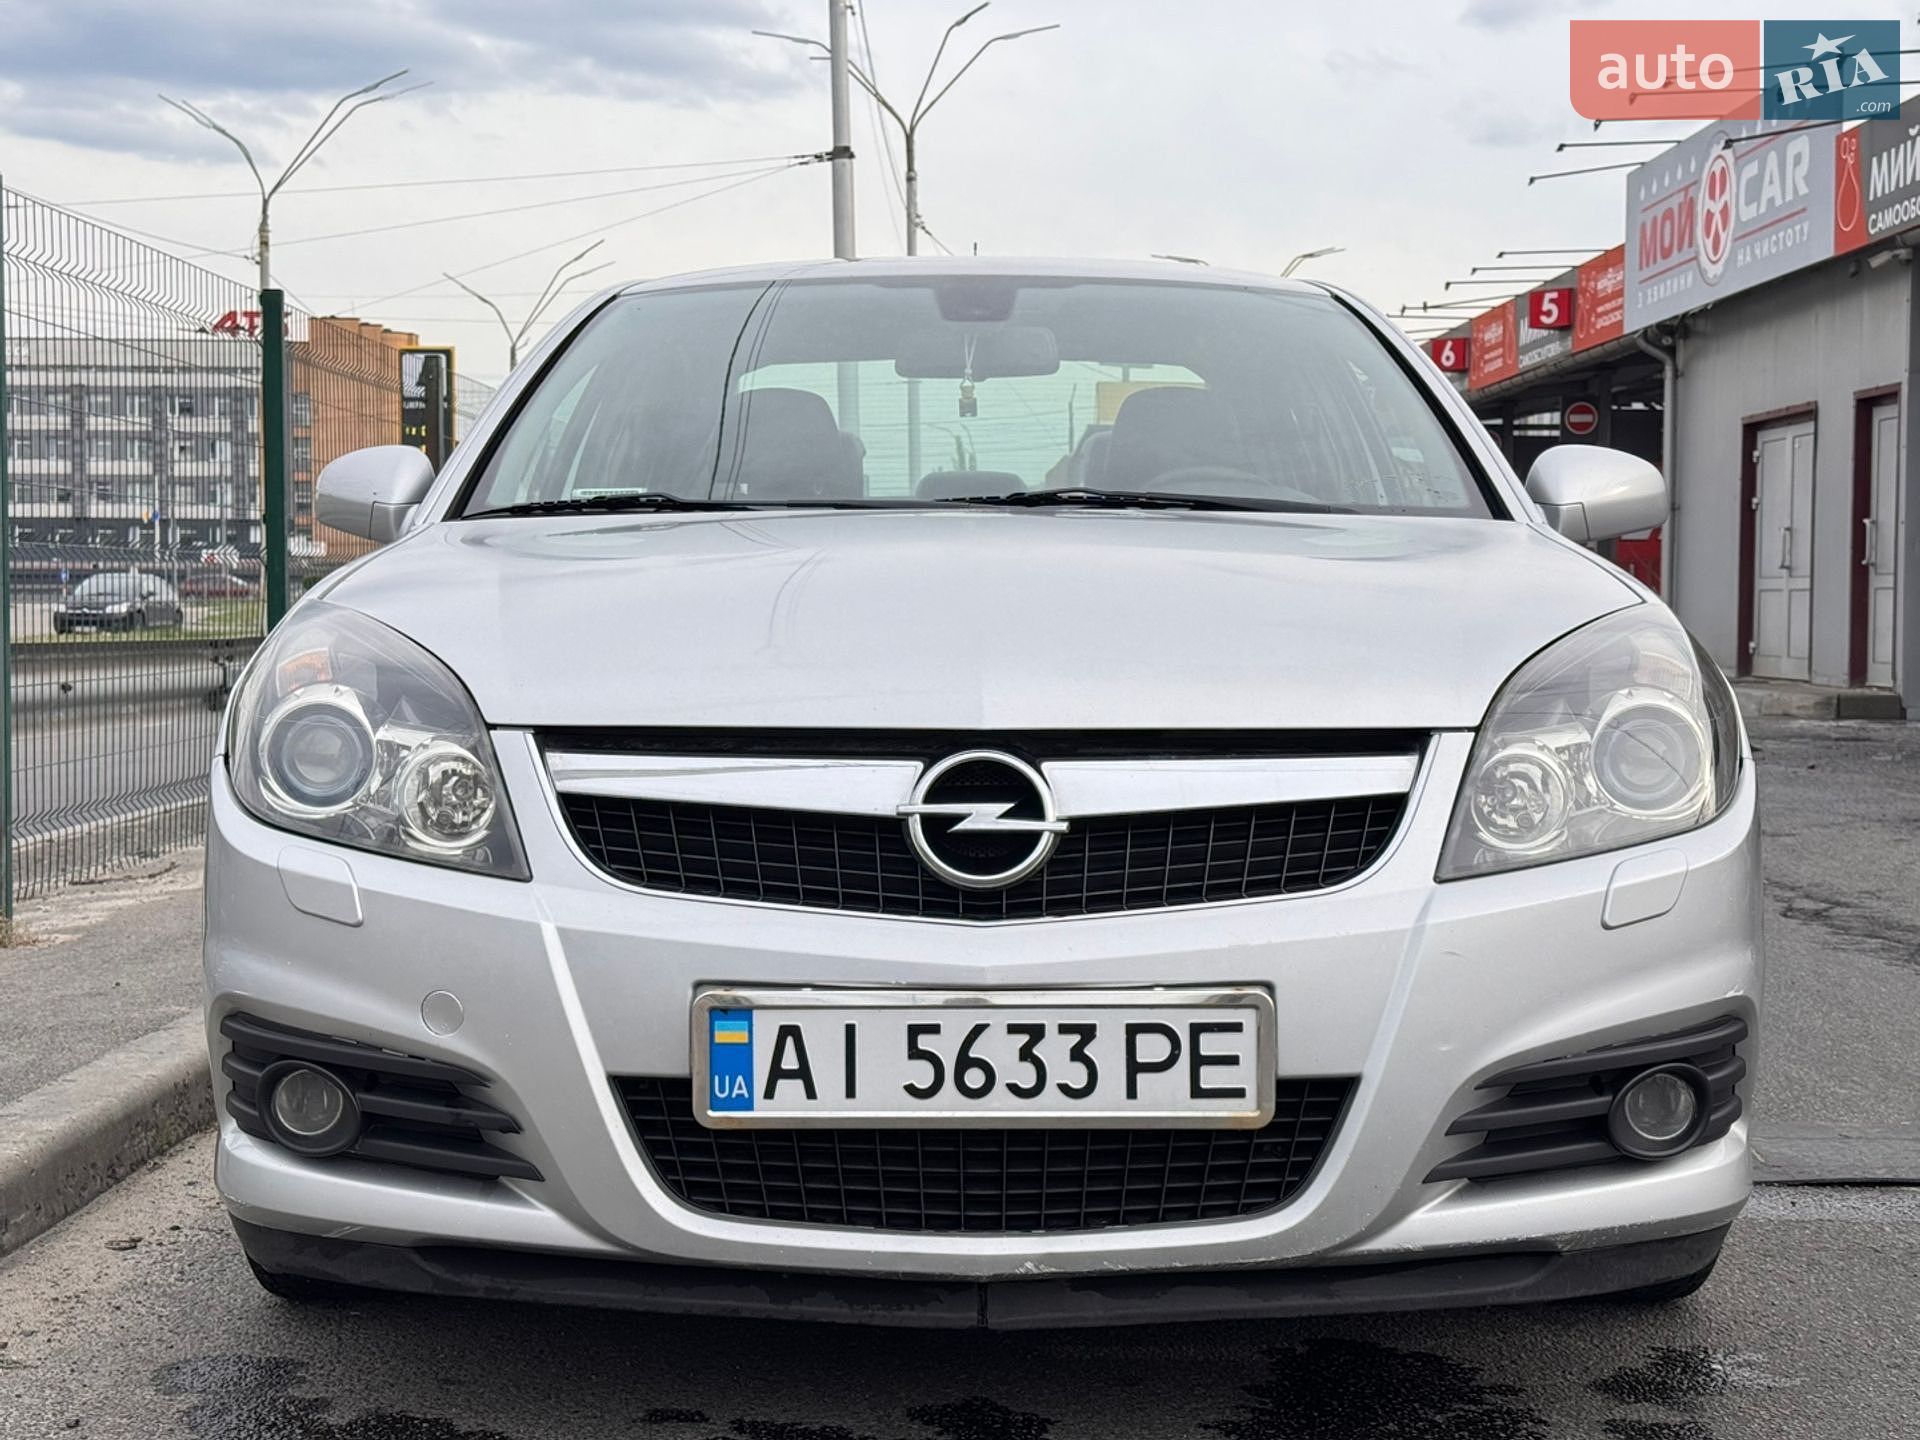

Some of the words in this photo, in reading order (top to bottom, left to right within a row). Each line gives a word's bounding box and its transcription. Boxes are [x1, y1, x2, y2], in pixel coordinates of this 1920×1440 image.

[1738, 134, 1810, 222] CAR
[1539, 292, 1559, 325] 5
[1440, 340, 1456, 367] 6
[763, 1023, 857, 1100] AI
[902, 1022, 1099, 1100] 5633
[1125, 1021, 1247, 1100] PE
[714, 1075, 749, 1099] UA
